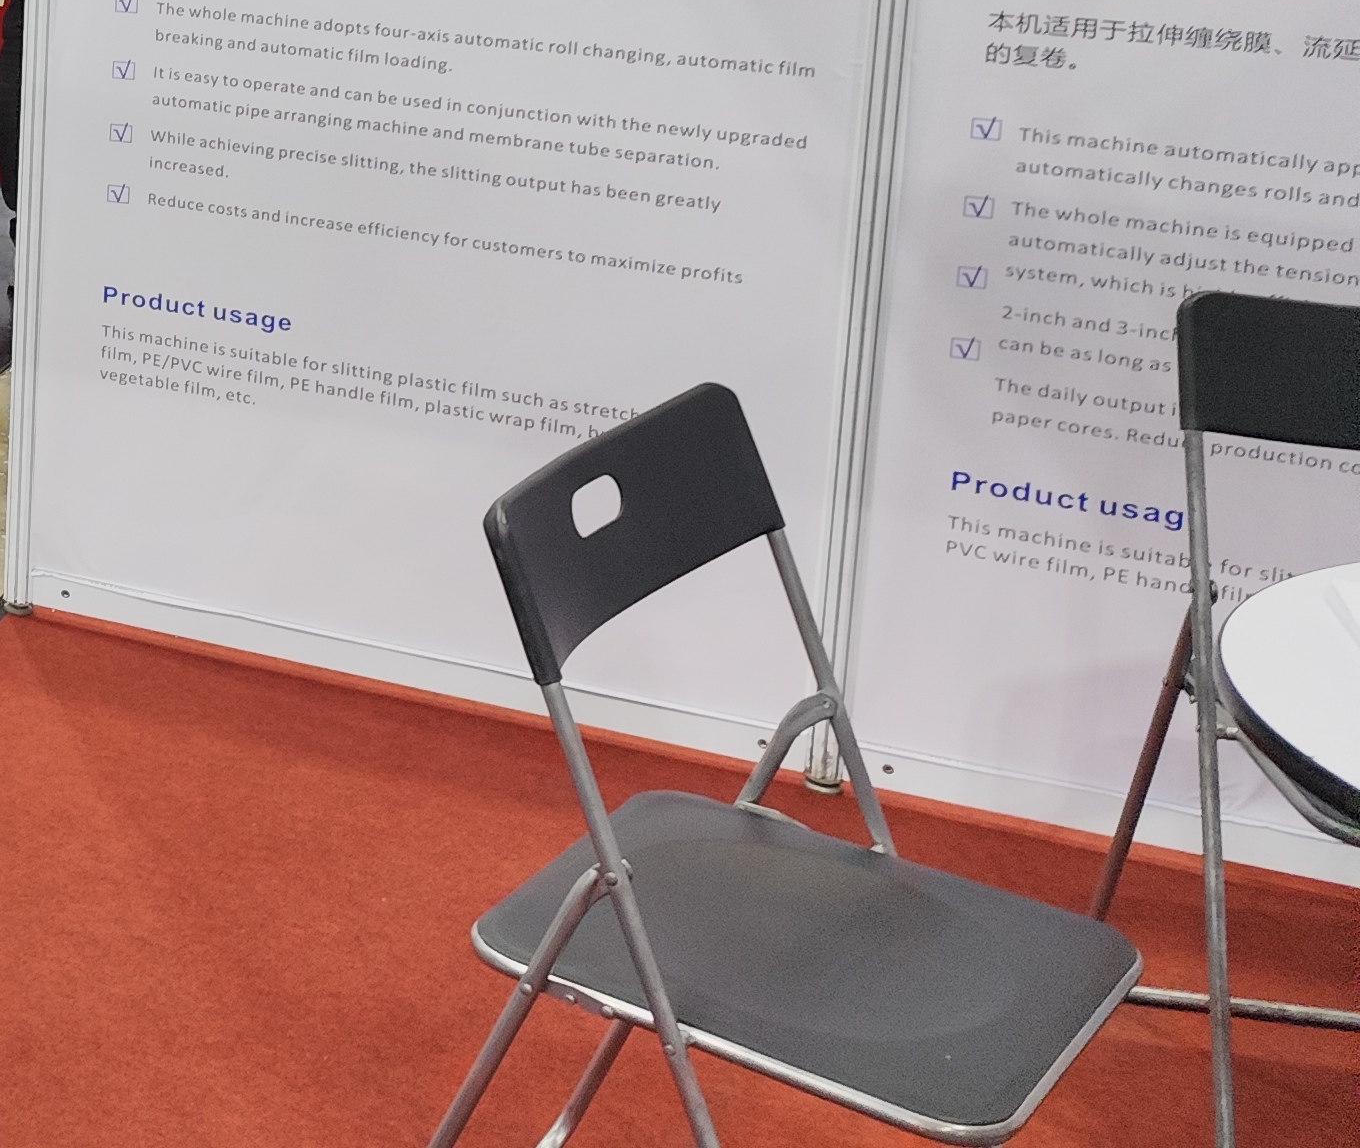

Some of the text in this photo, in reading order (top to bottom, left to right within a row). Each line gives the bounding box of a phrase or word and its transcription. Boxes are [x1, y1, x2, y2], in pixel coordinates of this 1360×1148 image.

[156, 1, 816, 79] The whole machine adopts four-axis automatic roll changing, automatic film
[147, 192, 744, 285] Reduce costs and increase efficiency for customers to maximize profits
[102, 285, 292, 334] Product usage
[950, 470, 1184, 532] Product usag
